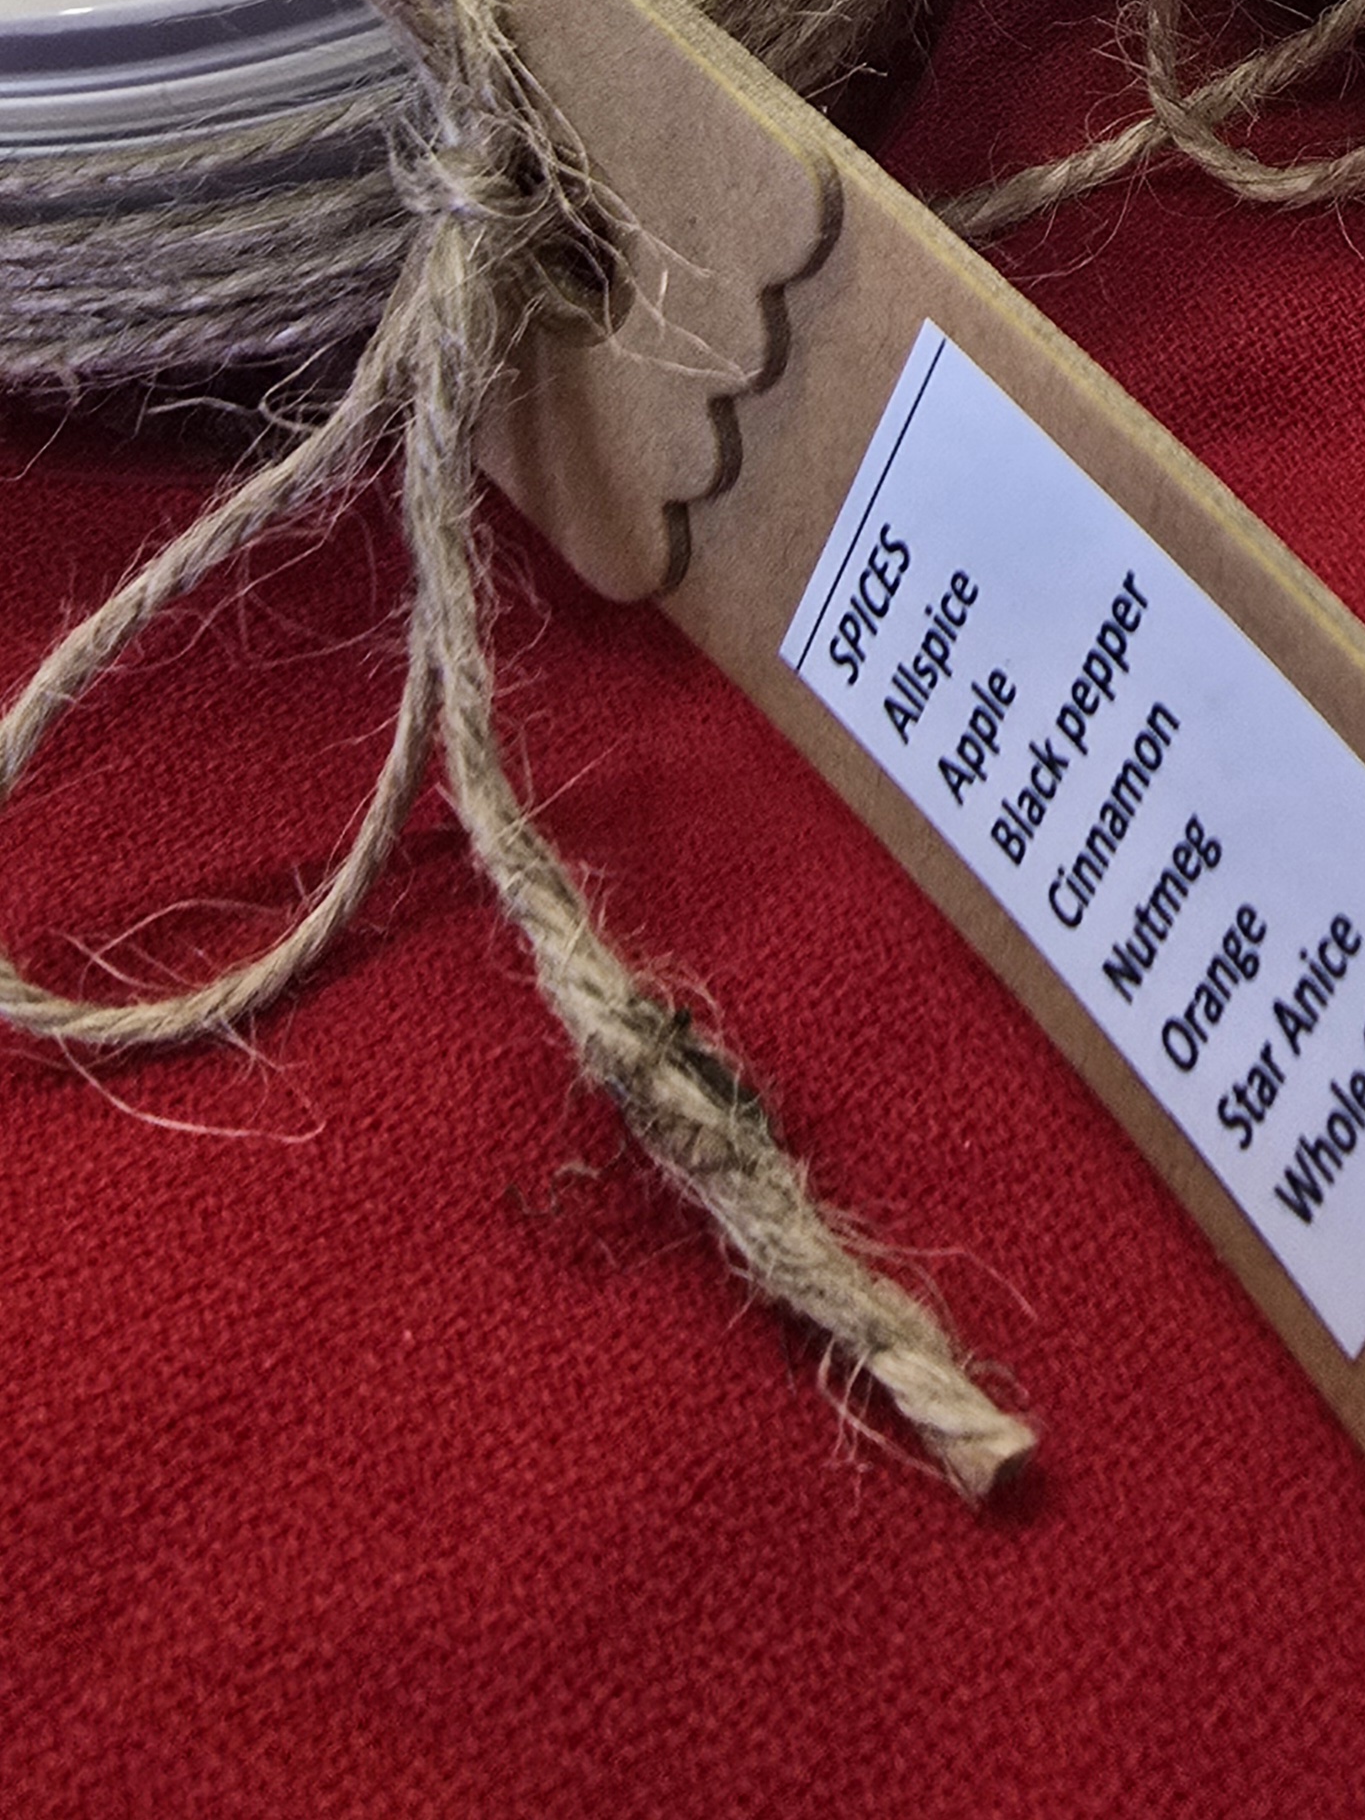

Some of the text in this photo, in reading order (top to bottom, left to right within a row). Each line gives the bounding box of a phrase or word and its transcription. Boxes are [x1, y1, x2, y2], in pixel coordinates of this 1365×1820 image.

[829, 523, 911, 685] SPICES
[883, 569, 979, 744] Allspice
[938, 667, 1016, 805] Apple
[990, 570, 1148, 865] Black pepper
[1048, 701, 1181, 928] Cinnamon
[1102, 813, 1222, 1004] Nutmeg
[1161, 903, 1267, 1072] Orange
[1217, 913, 1363, 1150] Star Anice
